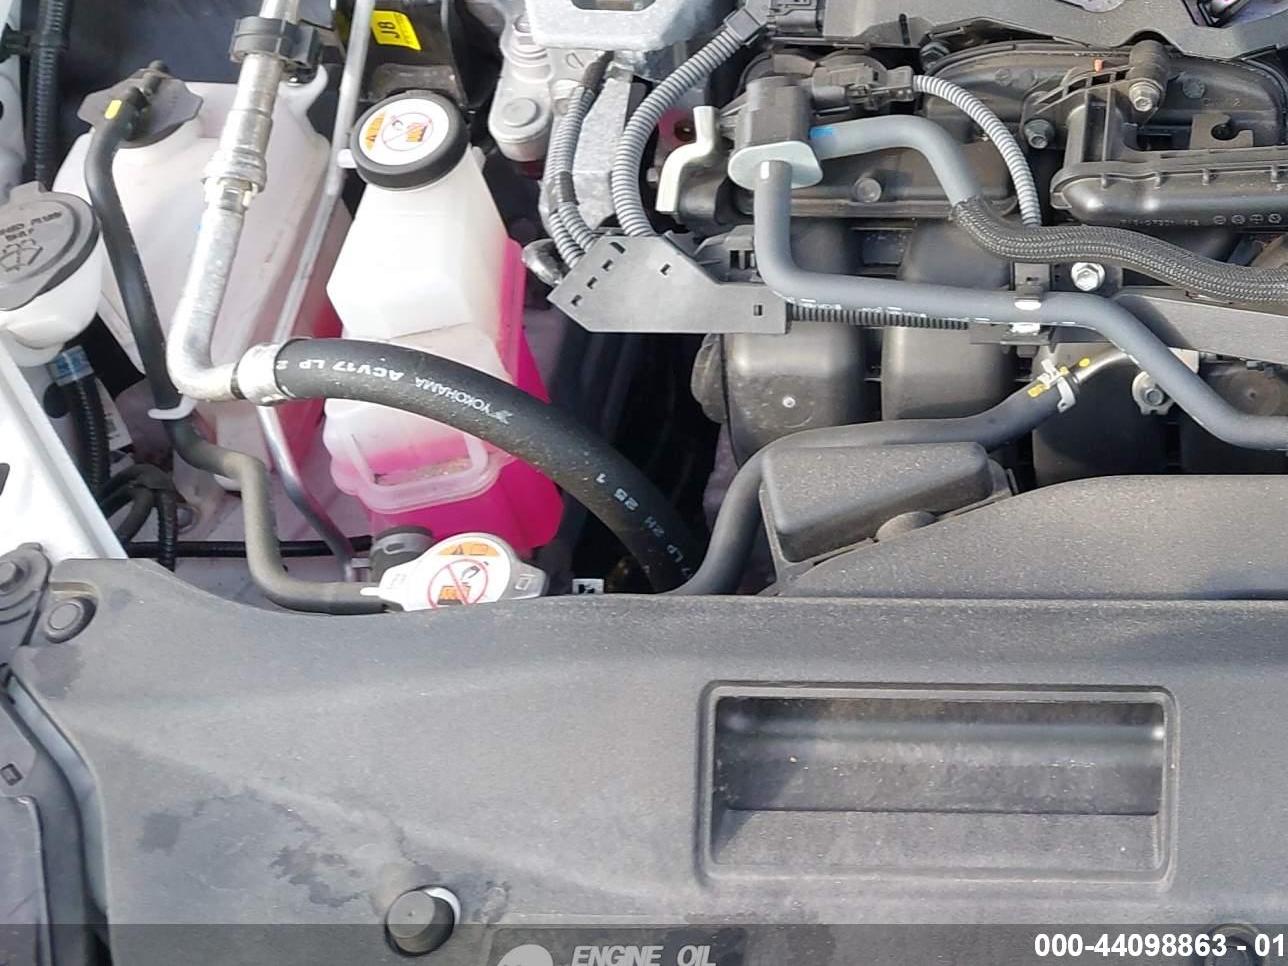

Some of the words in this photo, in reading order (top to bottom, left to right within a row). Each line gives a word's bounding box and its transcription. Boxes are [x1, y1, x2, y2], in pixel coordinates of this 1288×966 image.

[377, 21, 400, 39] J8
[299, 358, 326, 370] LP
[332, 361, 405, 382] ACV17
[415, 376, 492, 418] YOKOHAMA
[570, 945, 665, 966] ENGINE
[677, 945, 717, 966] OIL
